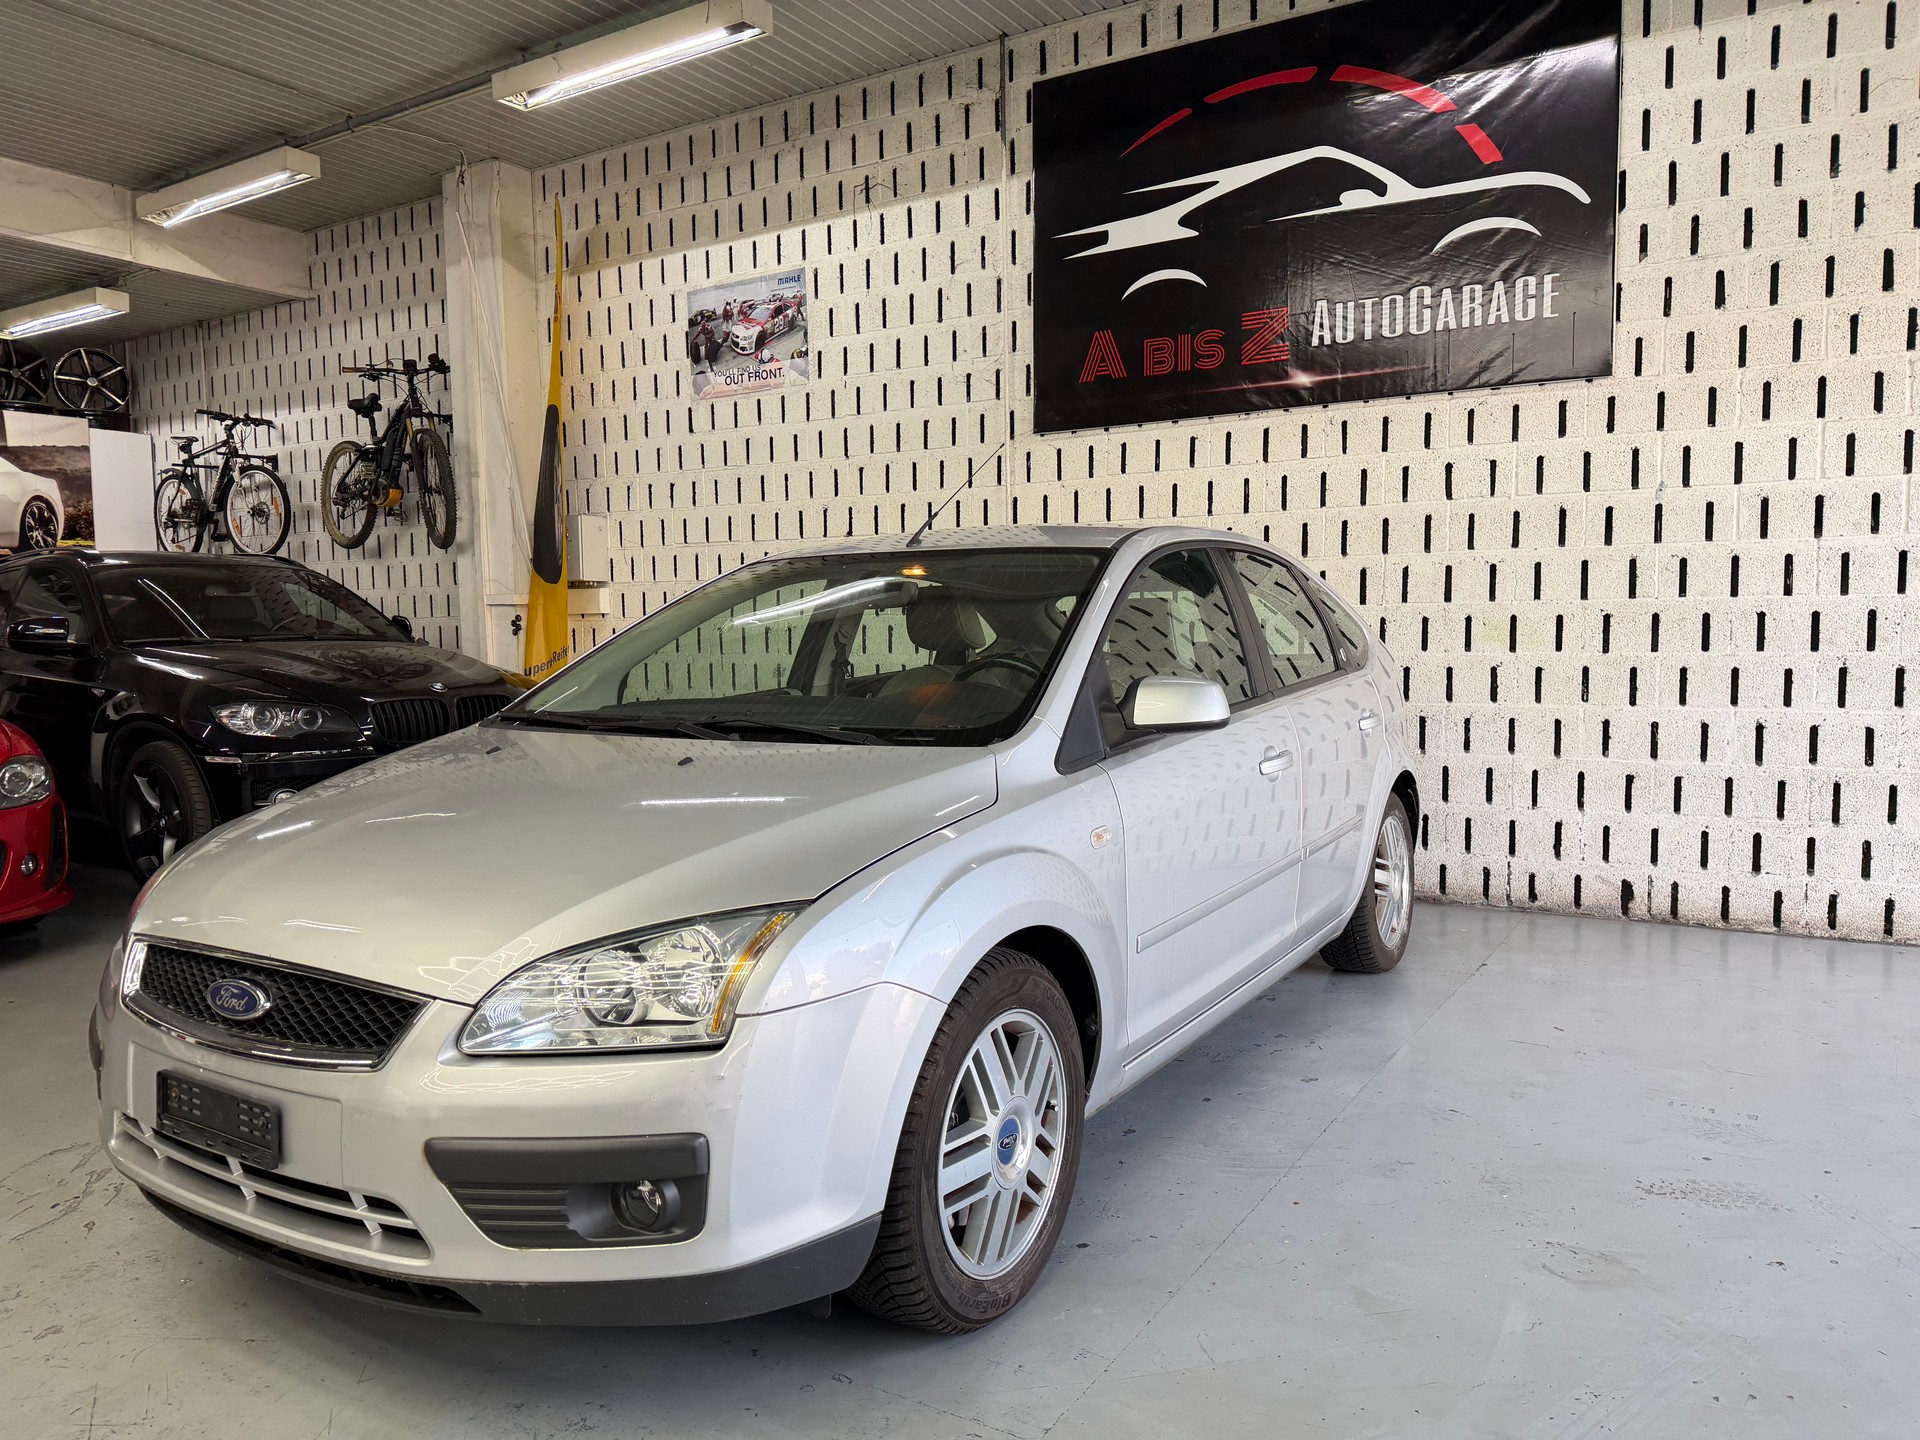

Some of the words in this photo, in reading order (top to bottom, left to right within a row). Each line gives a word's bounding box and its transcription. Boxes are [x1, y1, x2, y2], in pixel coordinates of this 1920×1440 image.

[778, 275, 801, 285] MAHLE
[1079, 329, 1127, 383] A
[1143, 329, 1225, 377] BIS
[1241, 307, 1289, 365] Z
[725, 373, 745, 386] OUT
[748, 367, 785, 383] FRONT.
[216, 985, 249, 1011] Ford
[1041, 982, 1076, 1045] YOKOHAMA
[957, 1287, 1012, 1315] BluEarth
